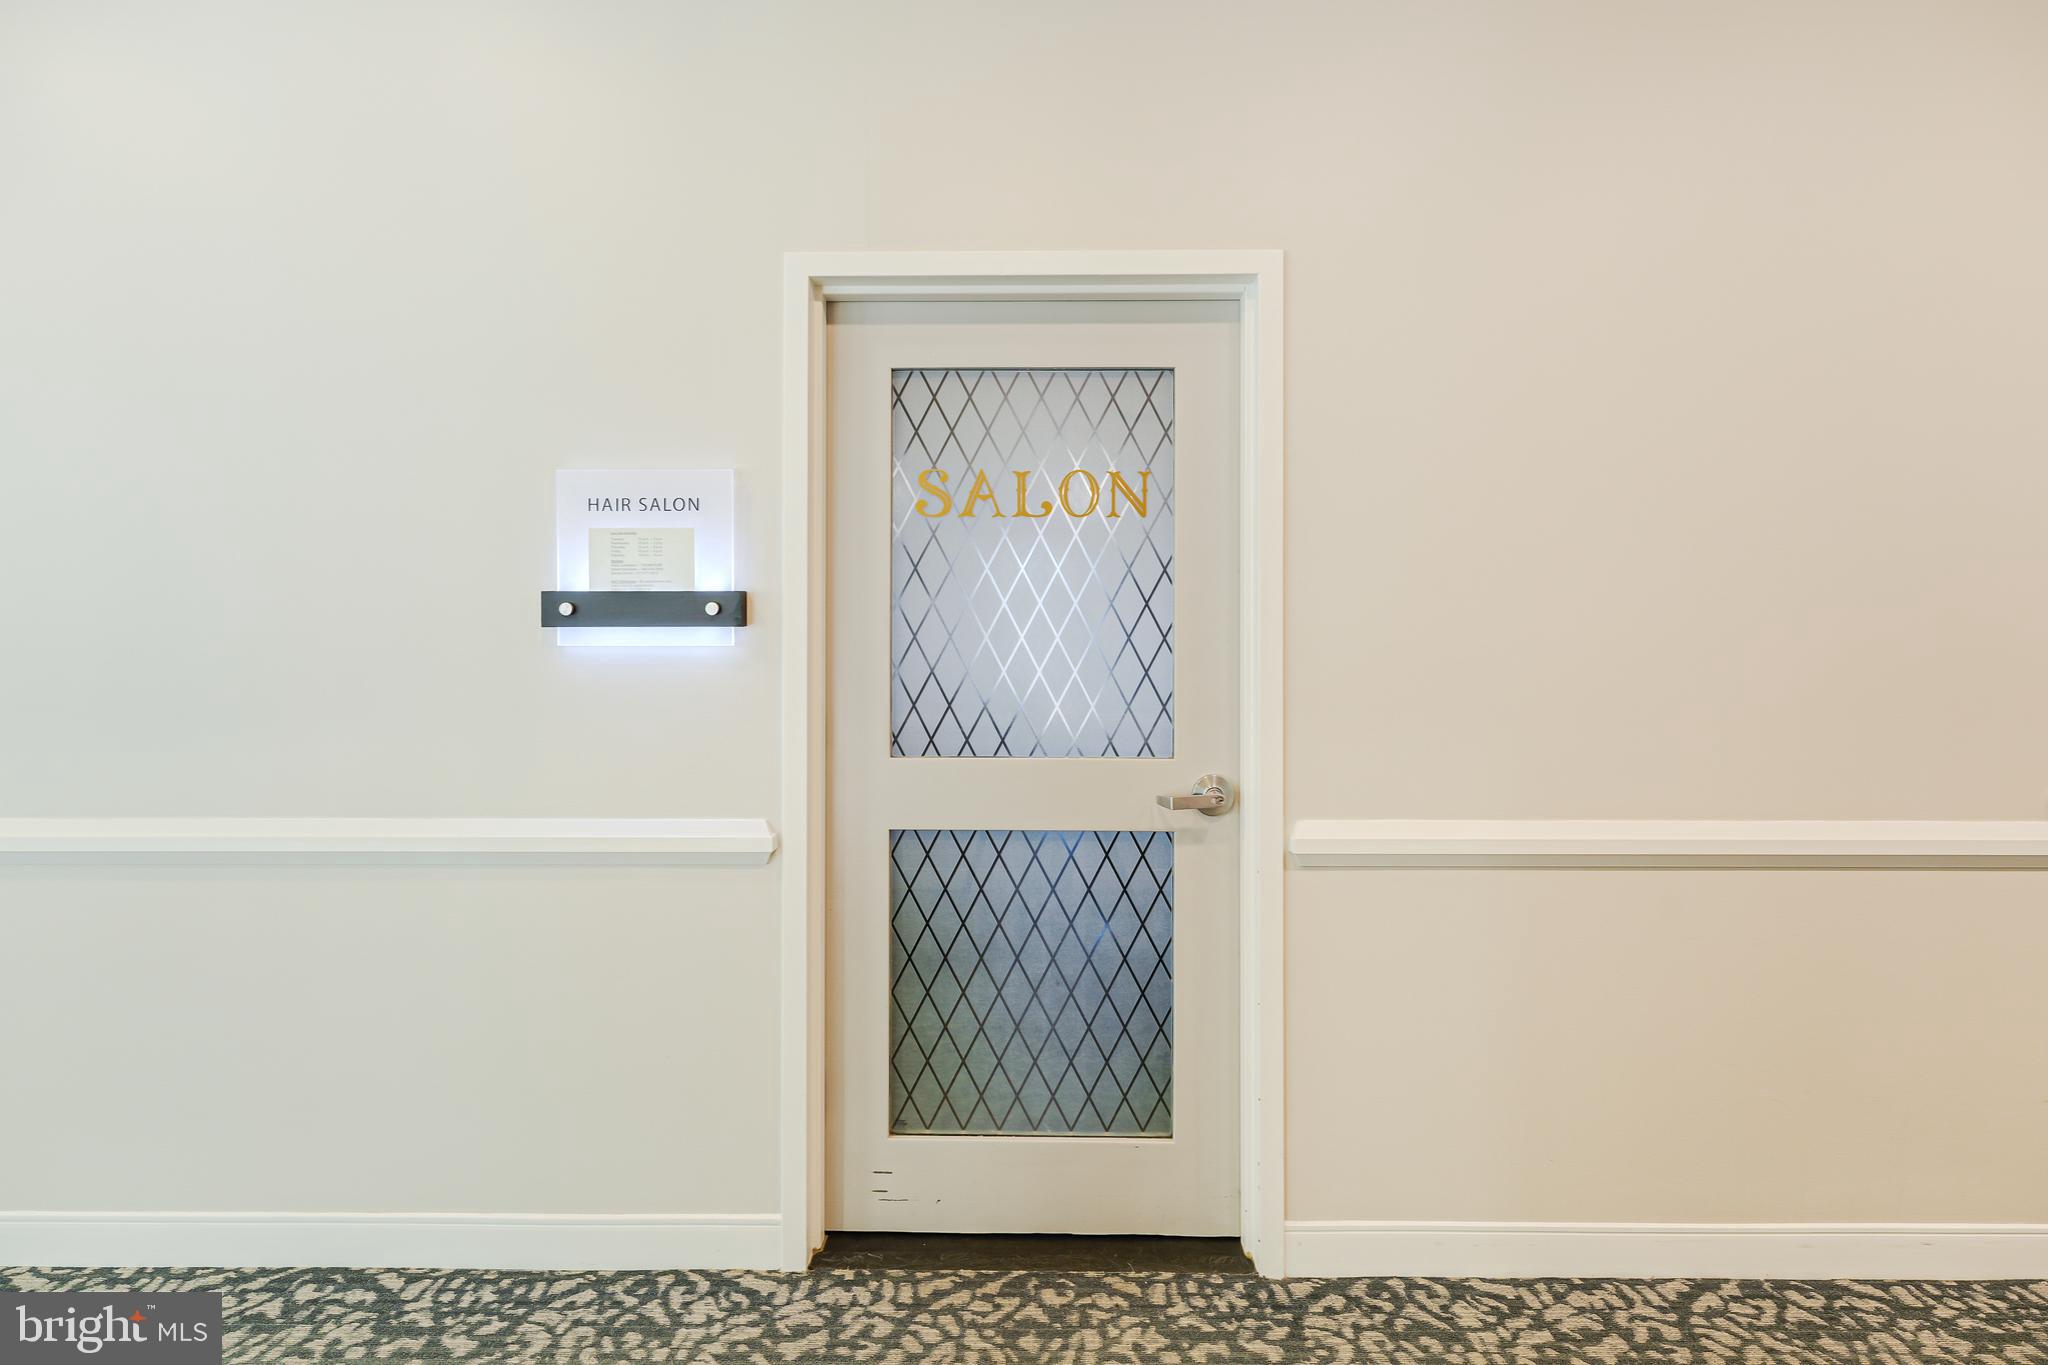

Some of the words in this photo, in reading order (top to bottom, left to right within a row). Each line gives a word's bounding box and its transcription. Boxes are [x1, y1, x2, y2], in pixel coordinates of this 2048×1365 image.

[587, 497, 631, 512] HAIR
[638, 497, 701, 512] SALON
[914, 468, 1151, 519] SALON
